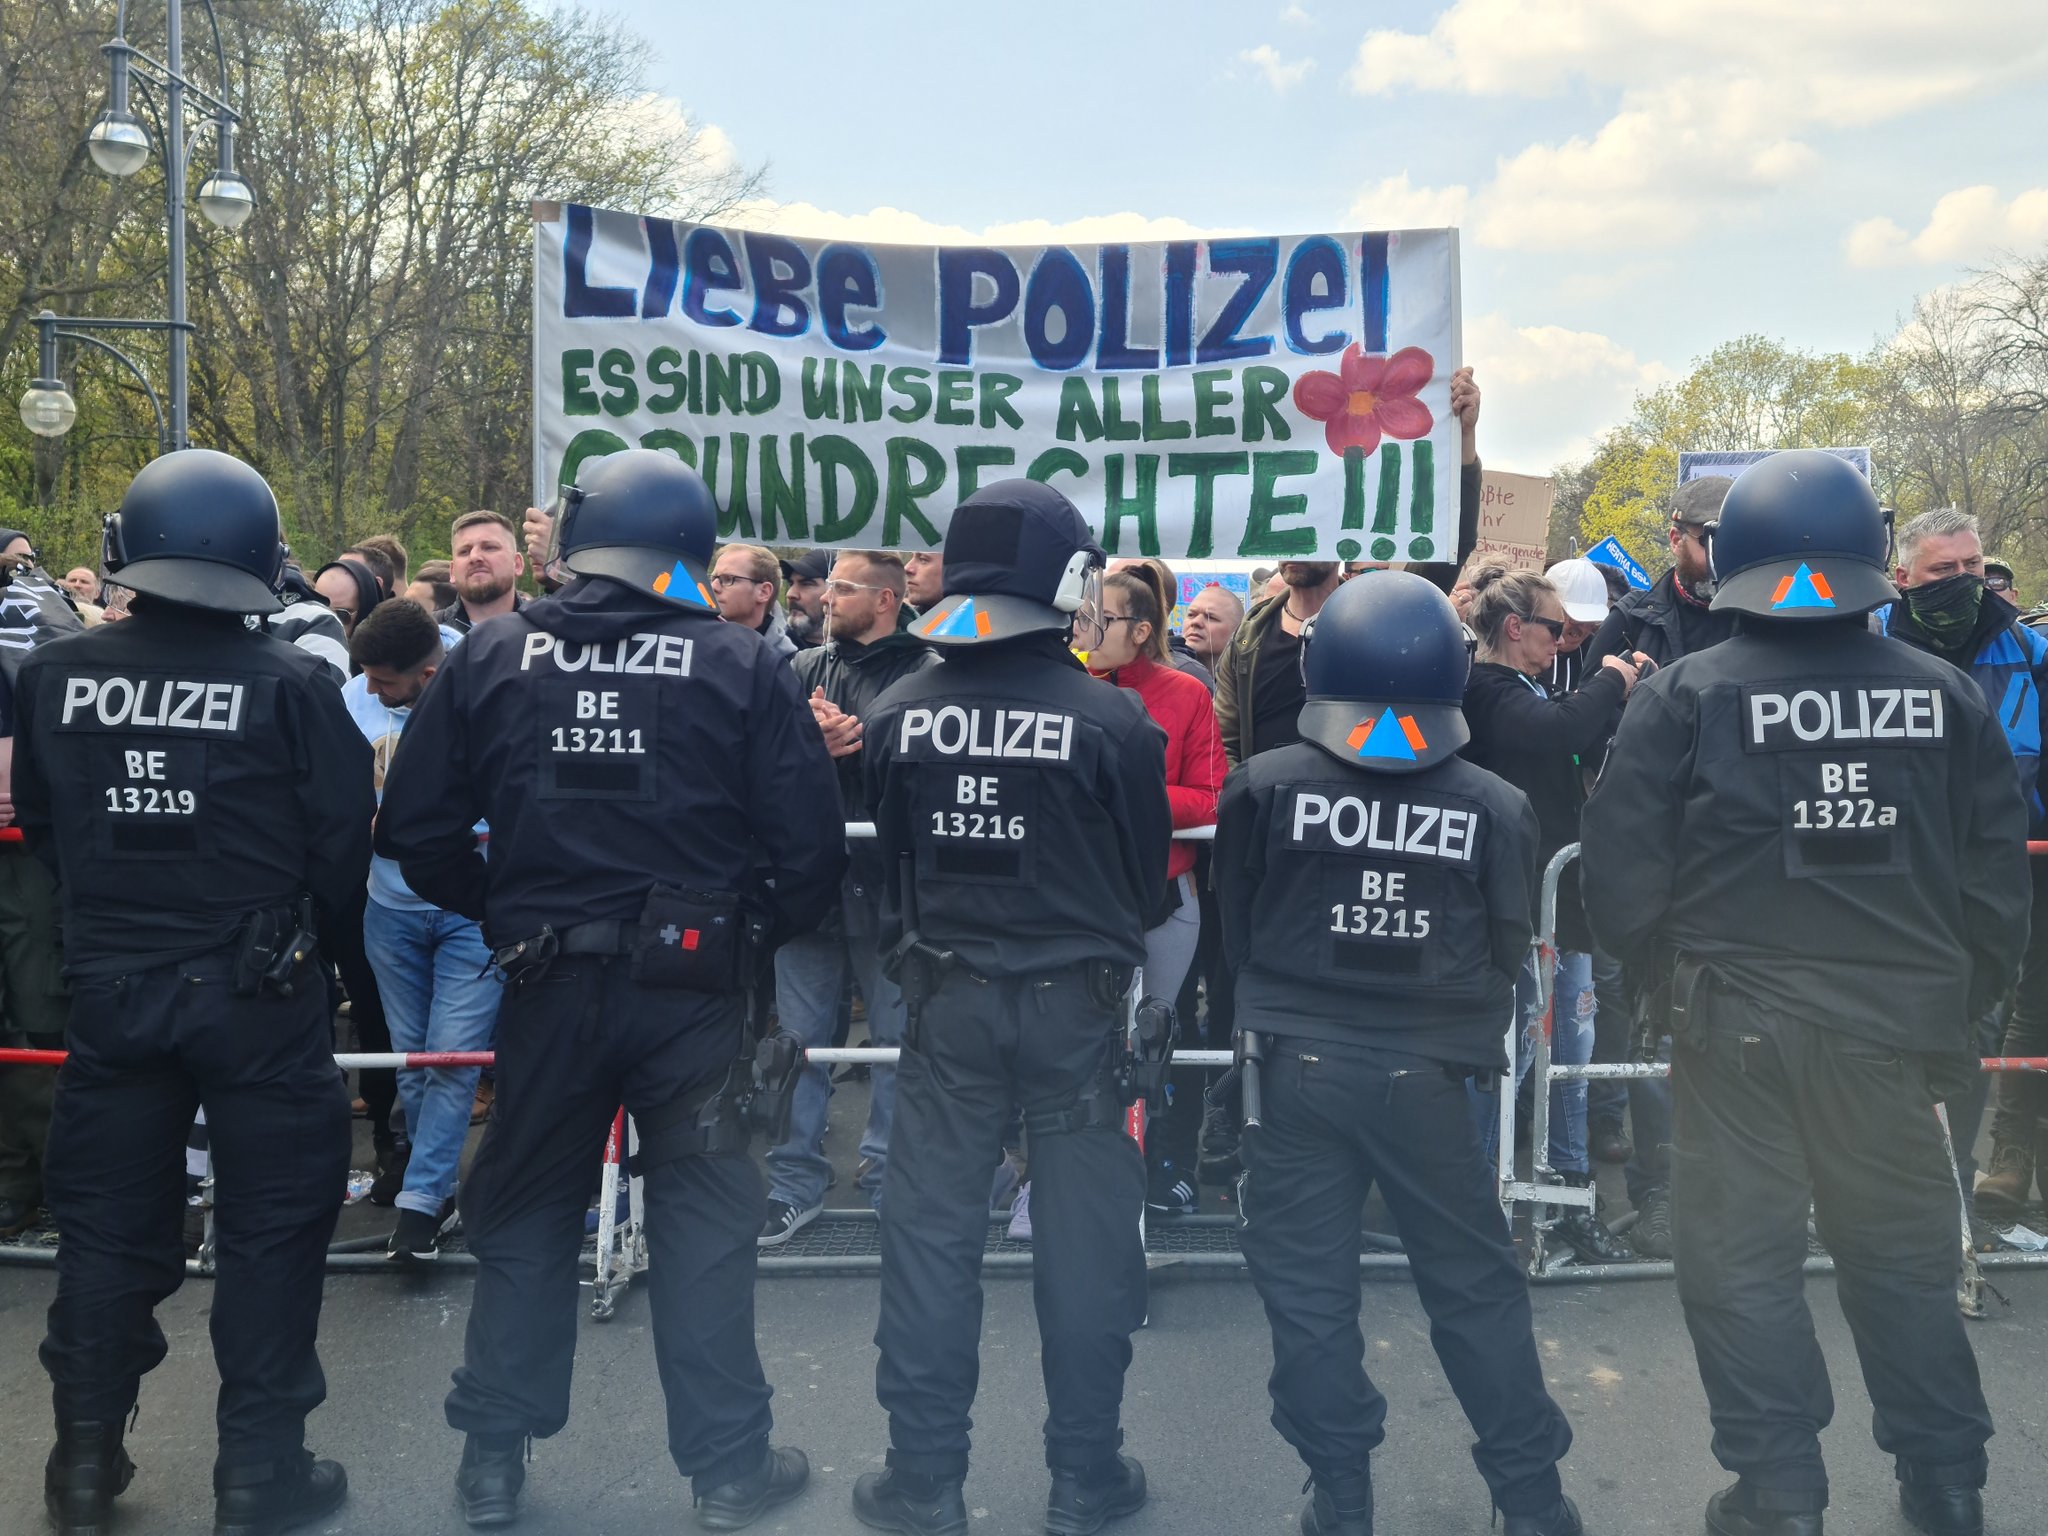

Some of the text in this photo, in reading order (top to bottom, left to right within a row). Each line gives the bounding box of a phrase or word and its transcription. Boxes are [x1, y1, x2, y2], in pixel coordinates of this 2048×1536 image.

[801, 356, 1024, 429] UNSER
[1056, 366, 1292, 442] ALLER
[558, 428, 1435, 561] UNDRHTE!!!
[1606, 540, 1631, 572] HERTHA
[520, 631, 694, 677] POLIZEI
[62, 677, 245, 732] POLIZEI
[576, 690, 620, 721] BE
[1750, 688, 1944, 743] POLIZEI
[551, 726, 645, 754] 13211
[900, 705, 1074, 761] POLIZEI
[124, 750, 167, 781] BE
[1820, 762, 1869, 794] BE
[105, 787, 195, 815] 13219
[956, 774, 999, 806] BE
[931, 810, 1025, 840] 13216
[1293, 793, 1478, 861] POLIZEI
[1361, 870, 1406, 902] BE
[1330, 903, 1431, 938] 13215
